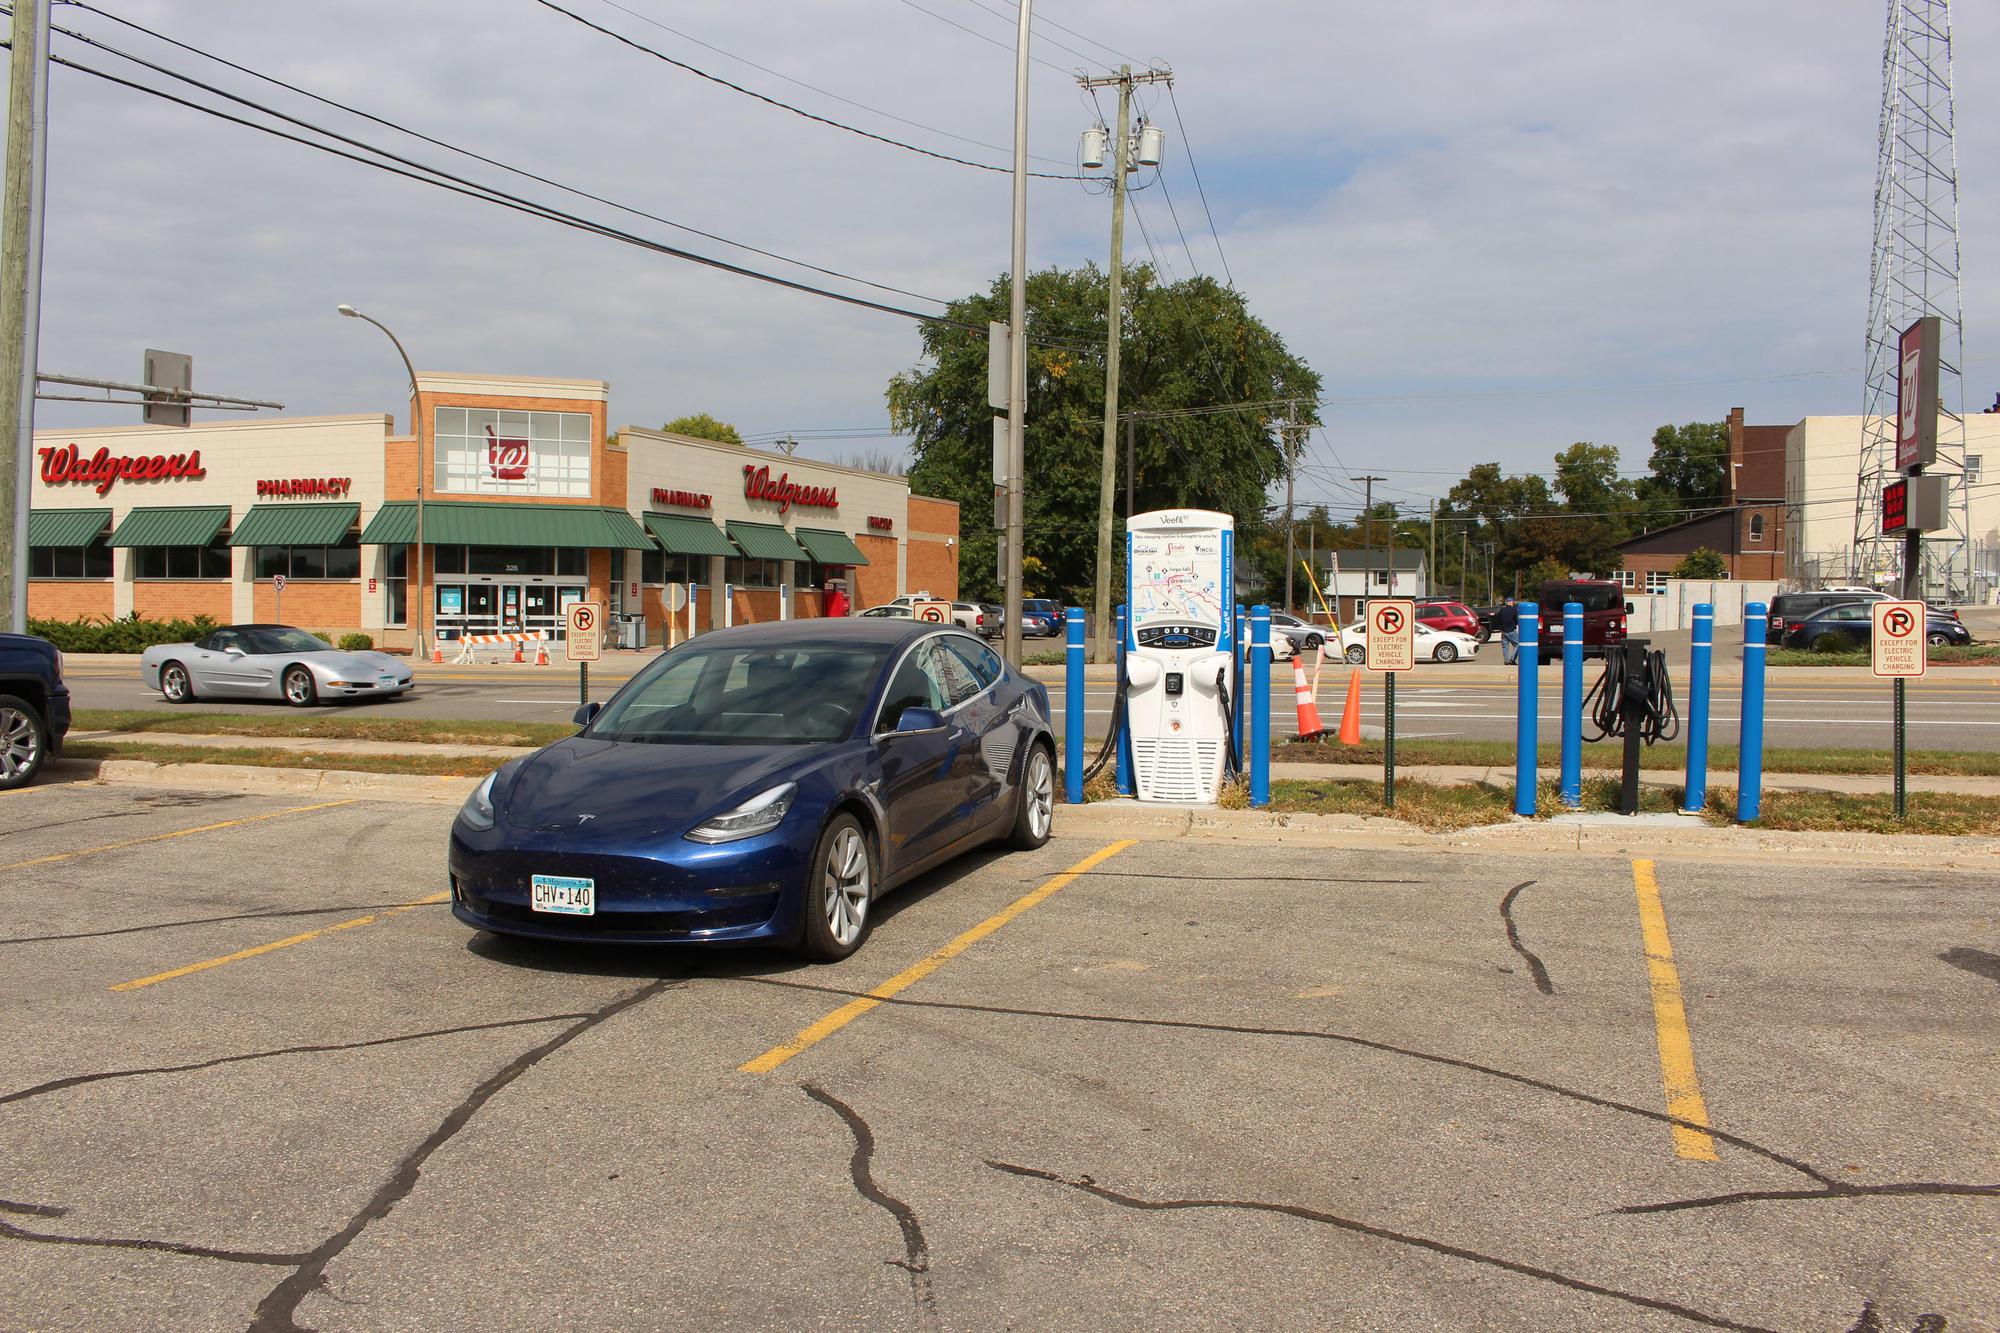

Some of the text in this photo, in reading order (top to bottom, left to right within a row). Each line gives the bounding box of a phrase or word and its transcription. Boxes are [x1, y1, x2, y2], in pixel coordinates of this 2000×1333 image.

[37, 443, 206, 494] Walgreens
[256, 478, 351, 497] PHARMACY
[652, 487, 712, 509] PHARMACY
[744, 465, 839, 513] Walgreens
[868, 516, 893, 530] PHOTO
[505, 564, 518, 572] 326
[535, 884, 590, 905] CHV 140
